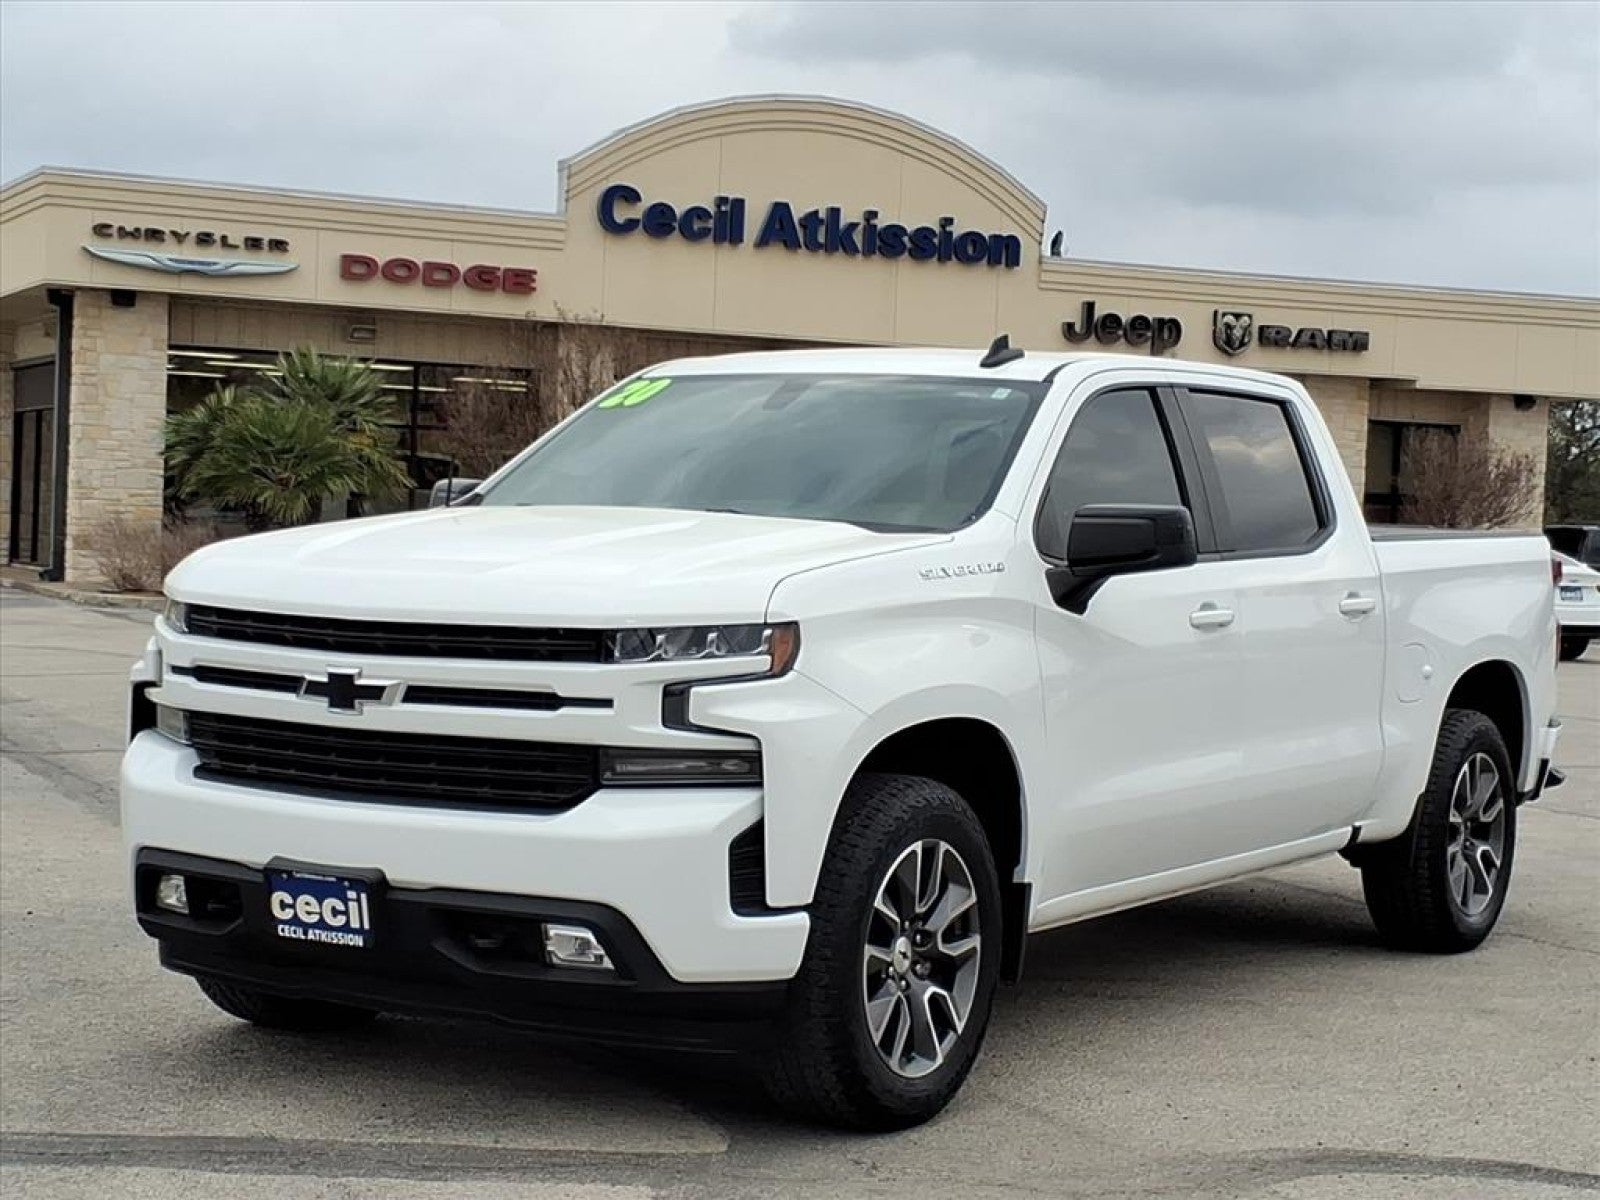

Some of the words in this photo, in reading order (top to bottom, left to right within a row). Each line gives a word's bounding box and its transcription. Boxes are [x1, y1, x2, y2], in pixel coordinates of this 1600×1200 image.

[91, 222, 290, 252] CHRYSLER
[598, 183, 745, 245] Cecil
[754, 201, 1021, 269] Atkission
[341, 254, 538, 295] DODGE
[1062, 300, 1182, 356] Jeep
[1258, 324, 1370, 352] RAM
[598, 378, 673, 407] 20
[271, 890, 370, 930] cecil
[277, 925, 306, 939] CECIL
[307, 929, 364, 946] ATKISSION
